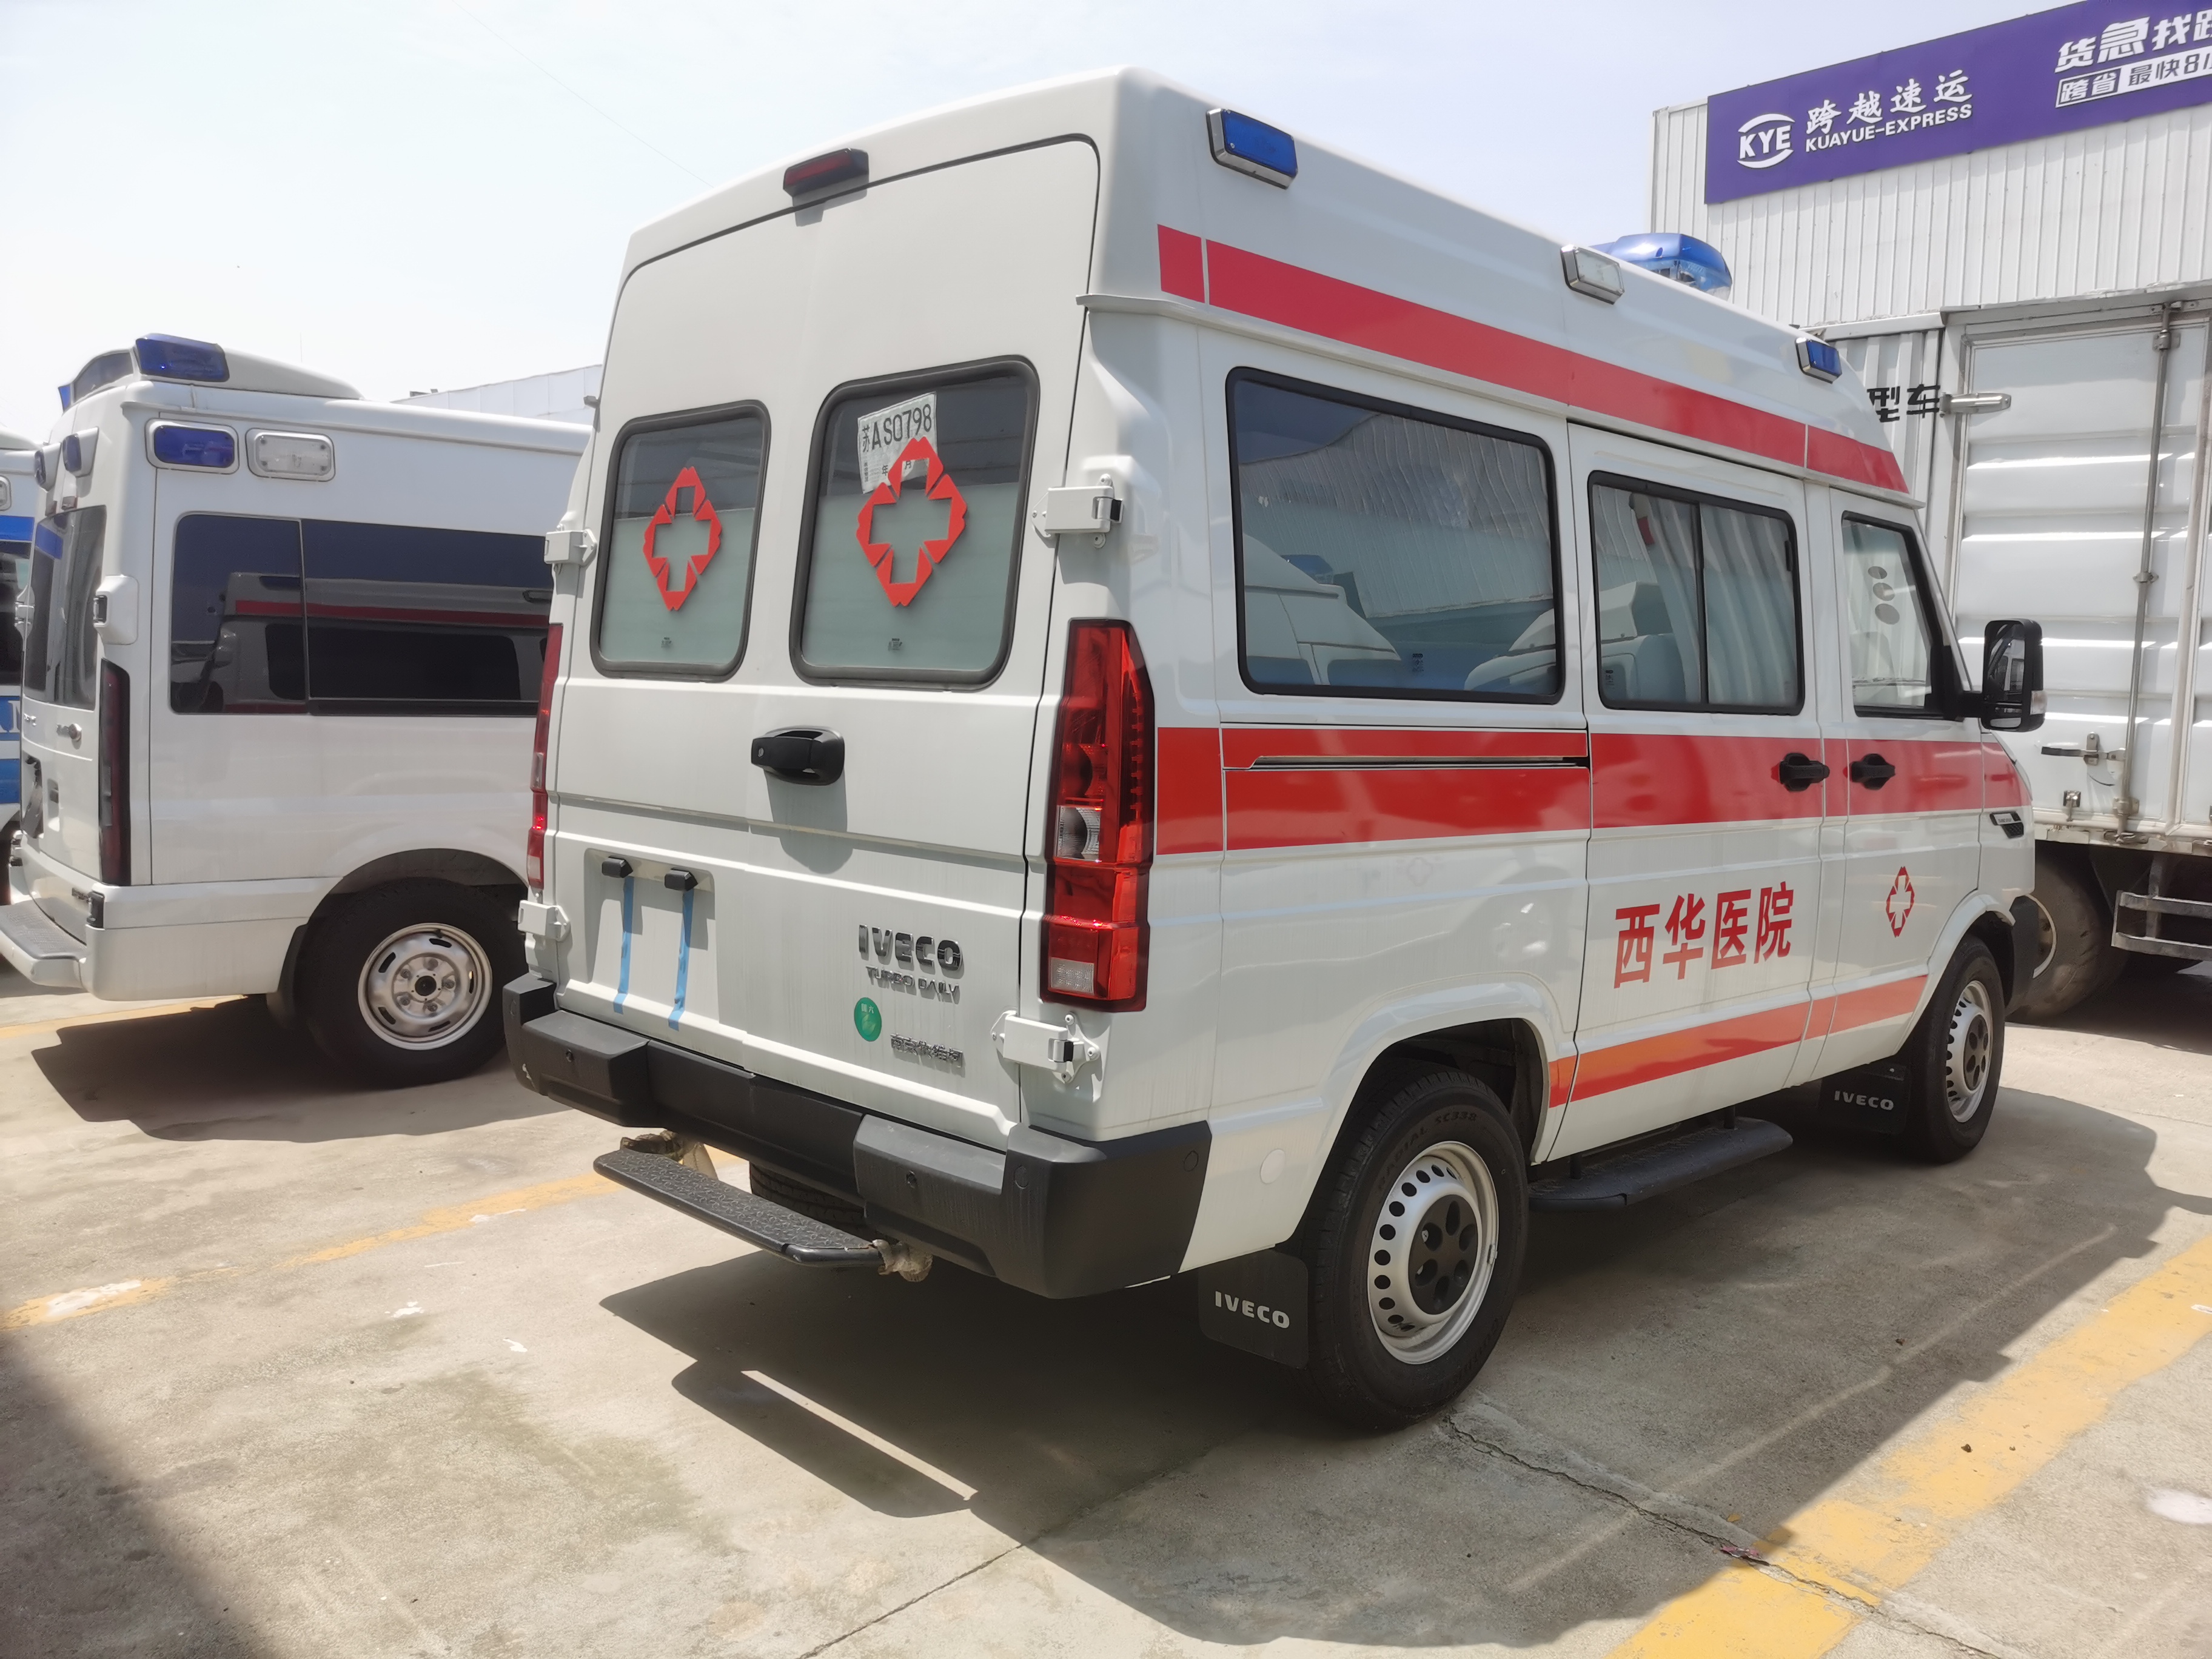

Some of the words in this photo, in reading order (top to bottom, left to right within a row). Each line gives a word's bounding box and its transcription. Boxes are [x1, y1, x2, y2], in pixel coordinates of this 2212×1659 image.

[1806, 70, 1972, 135] 跨越速运
[2060, 72, 2117, 103] 跨省
[1739, 125, 1791, 159] KYE
[1806, 104, 1972, 153] KUAYUE-EXPRESS
[1867, 384, 1940, 423] 型车
[858, 923, 962, 971] IVECO
[1614, 881, 1794, 989] 西华医院
[865, 965, 914, 988] TURBO
[917, 976, 960, 996] DAILY
[1834, 1090, 1894, 1111] IVECO
[1215, 1290, 1290, 1329] IVECO
